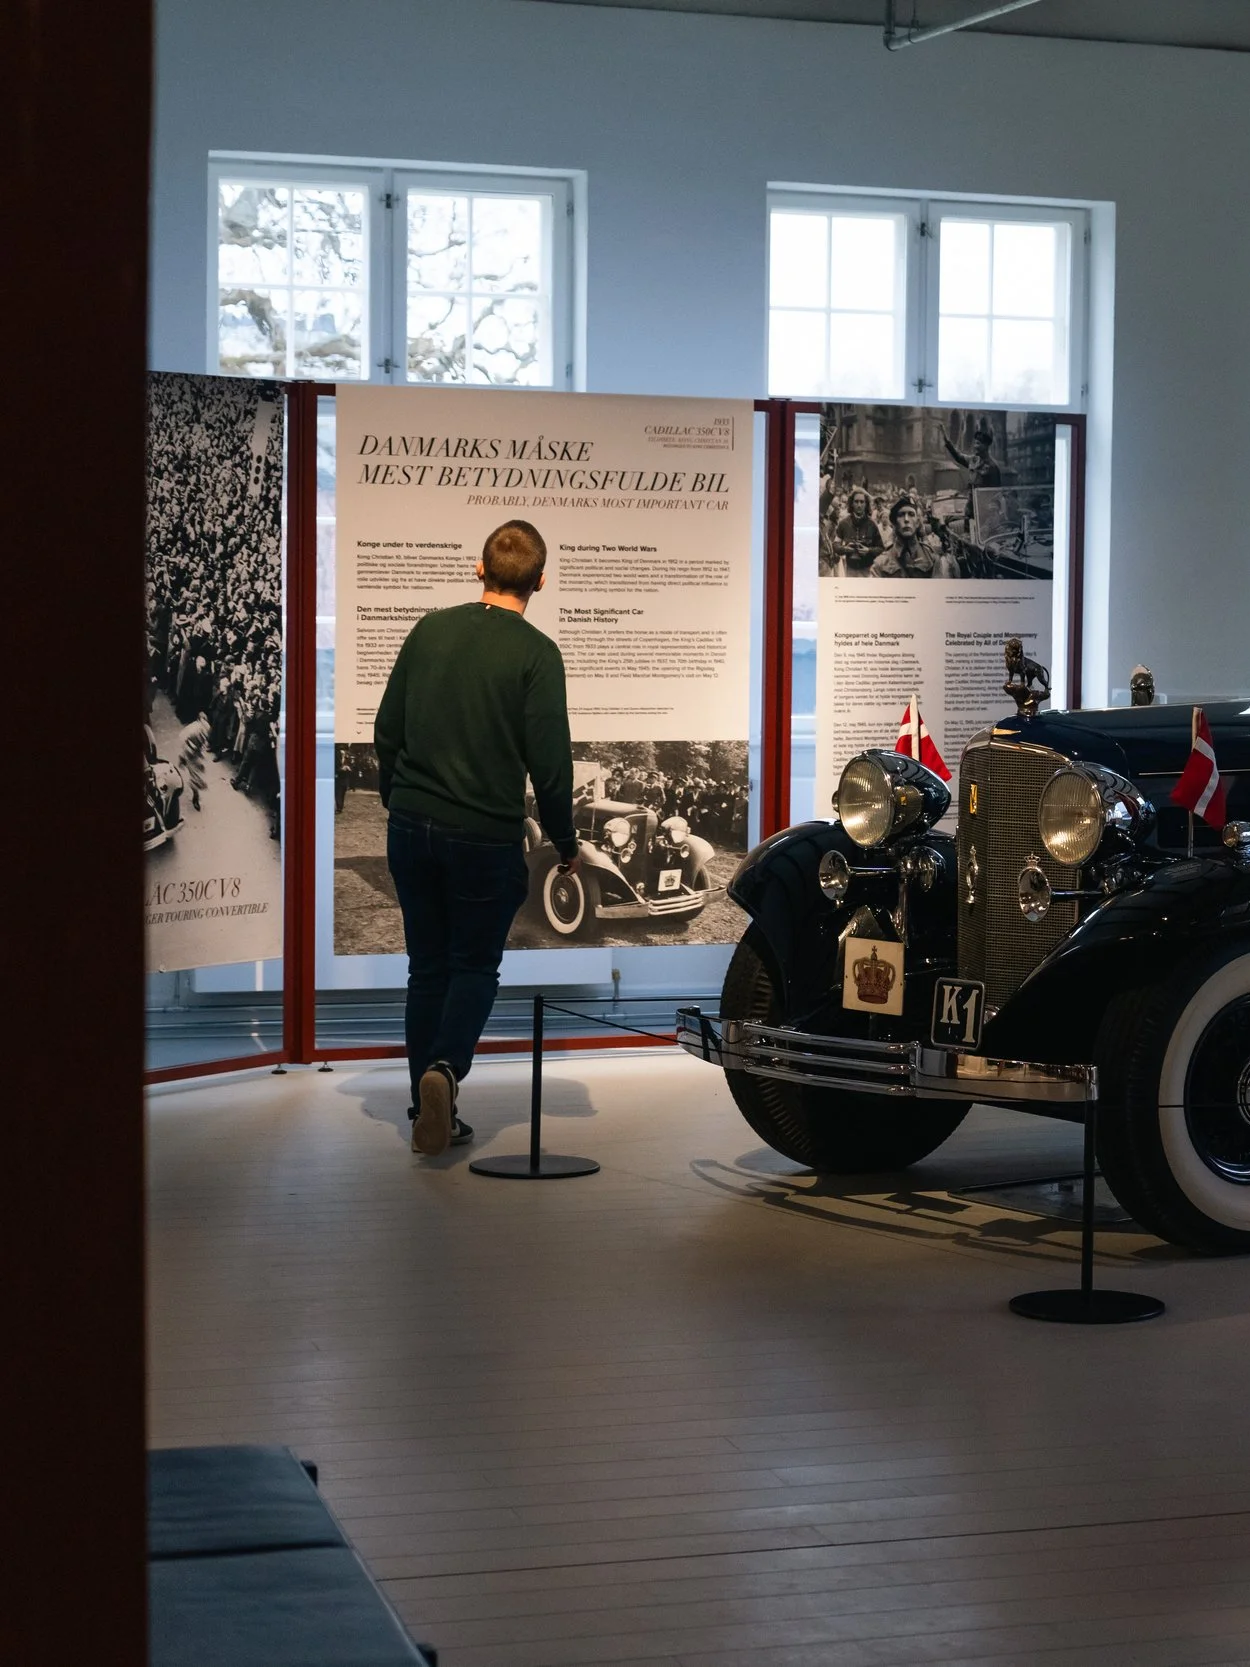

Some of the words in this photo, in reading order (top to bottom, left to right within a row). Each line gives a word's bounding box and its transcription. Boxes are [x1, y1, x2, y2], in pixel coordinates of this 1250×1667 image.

[644, 425, 696, 435] CADILLAC
[358, 435, 501, 459] DANMARKS
[505, 435, 593, 462] MÅSKE
[357, 464, 433, 486] MEST
[436, 466, 686, 492] BETYDNINGSFULDE
[690, 473, 730, 493] BIL
[466, 494, 530, 508] PROBABLY,
[531, 497, 598, 508] DENMARKS
[601, 498, 635, 509] MOST
[636, 499, 705, 510] IMPORTANT
[706, 500, 729, 510] CAR
[357, 540, 380, 548] Konge
[415, 542, 463, 550] verdenskrige
[560, 544, 575, 552] King
[577, 544, 600, 552] during
[593, 608, 630, 616] Significant
[177, 879, 216, 904] 350C
[220, 877, 241, 899] V8
[165, 908, 205, 923] TOURING
[205, 903, 269, 917] CONVERTIBLE
[940, 985, 979, 1043] K1
